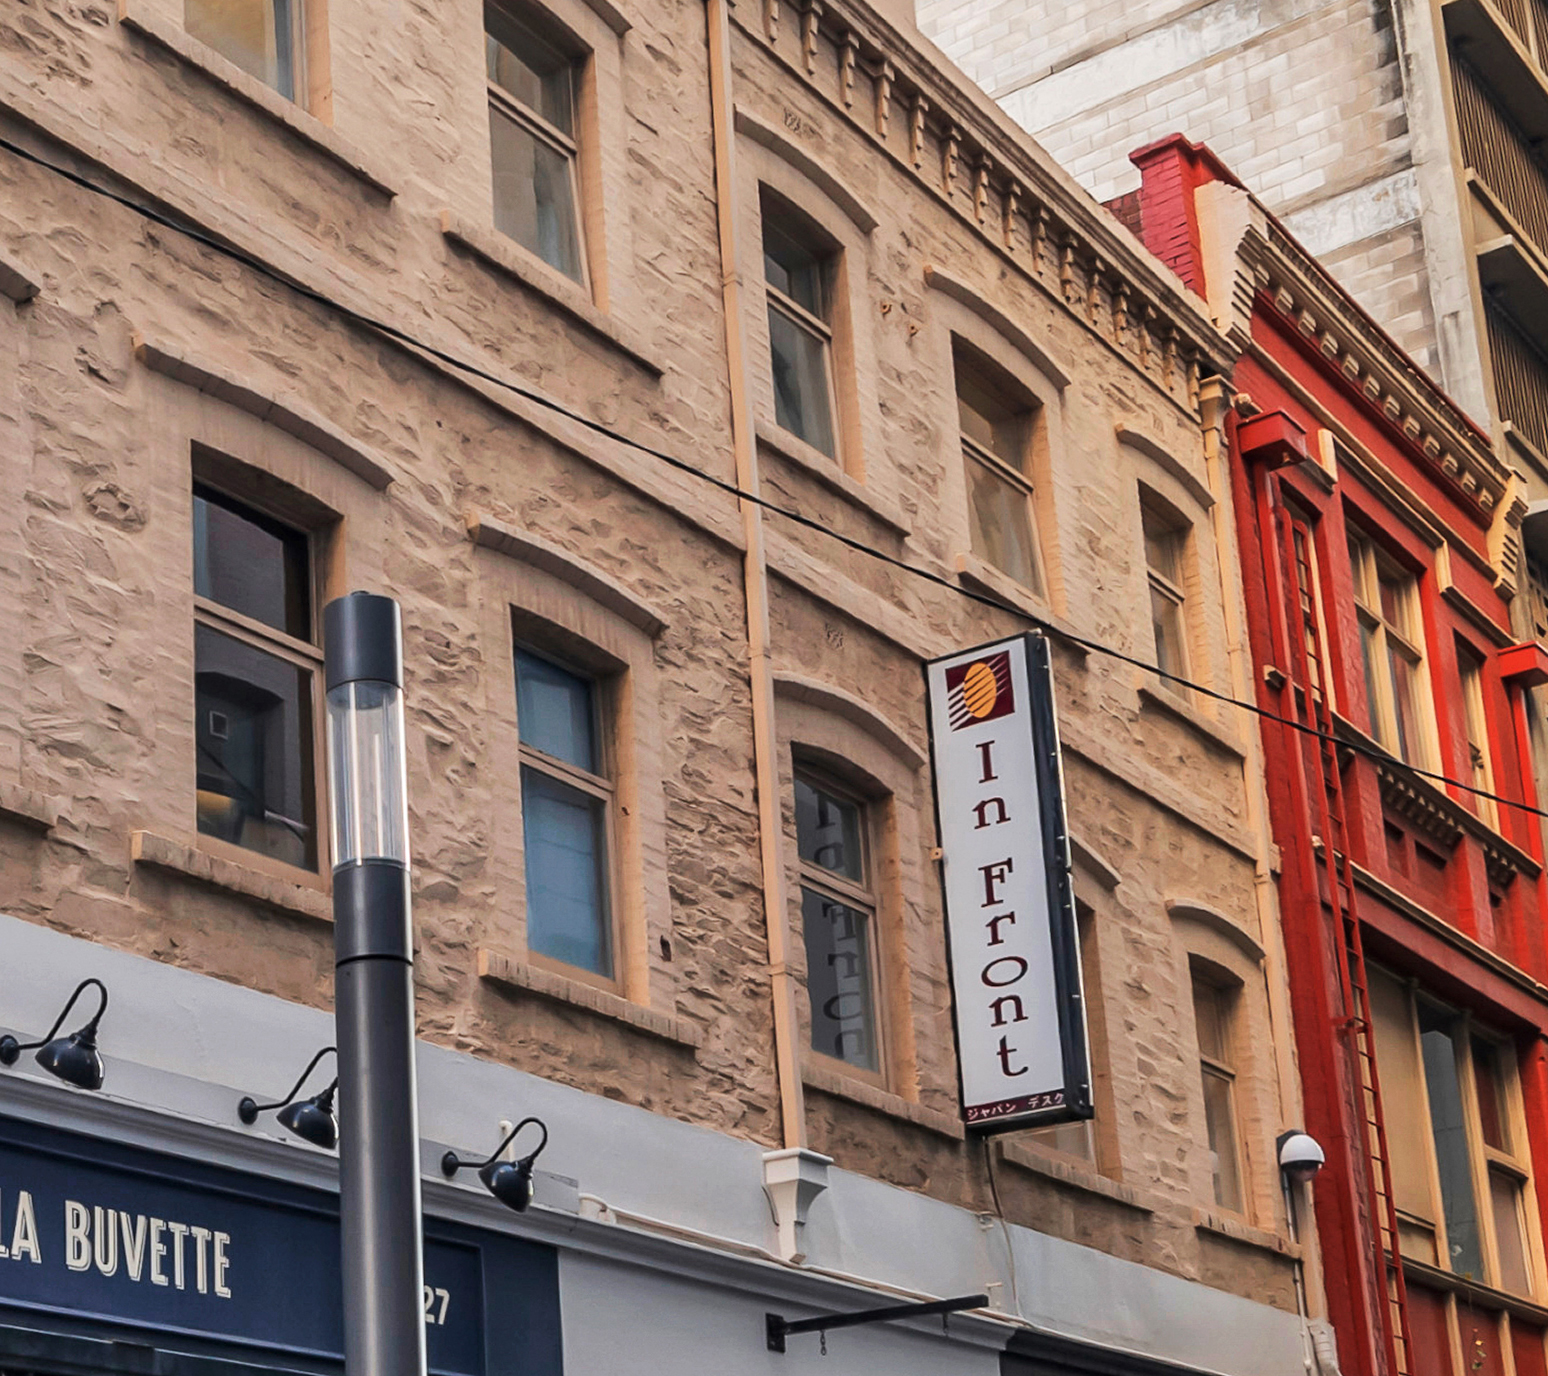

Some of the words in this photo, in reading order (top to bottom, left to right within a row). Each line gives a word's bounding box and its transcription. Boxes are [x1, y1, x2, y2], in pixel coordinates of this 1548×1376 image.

[972, 740, 1011, 829] In
[978, 857, 1029, 1077] Front
[65, 1198, 232, 1300] BUVETTE
[423, 1284, 450, 1325] 27
